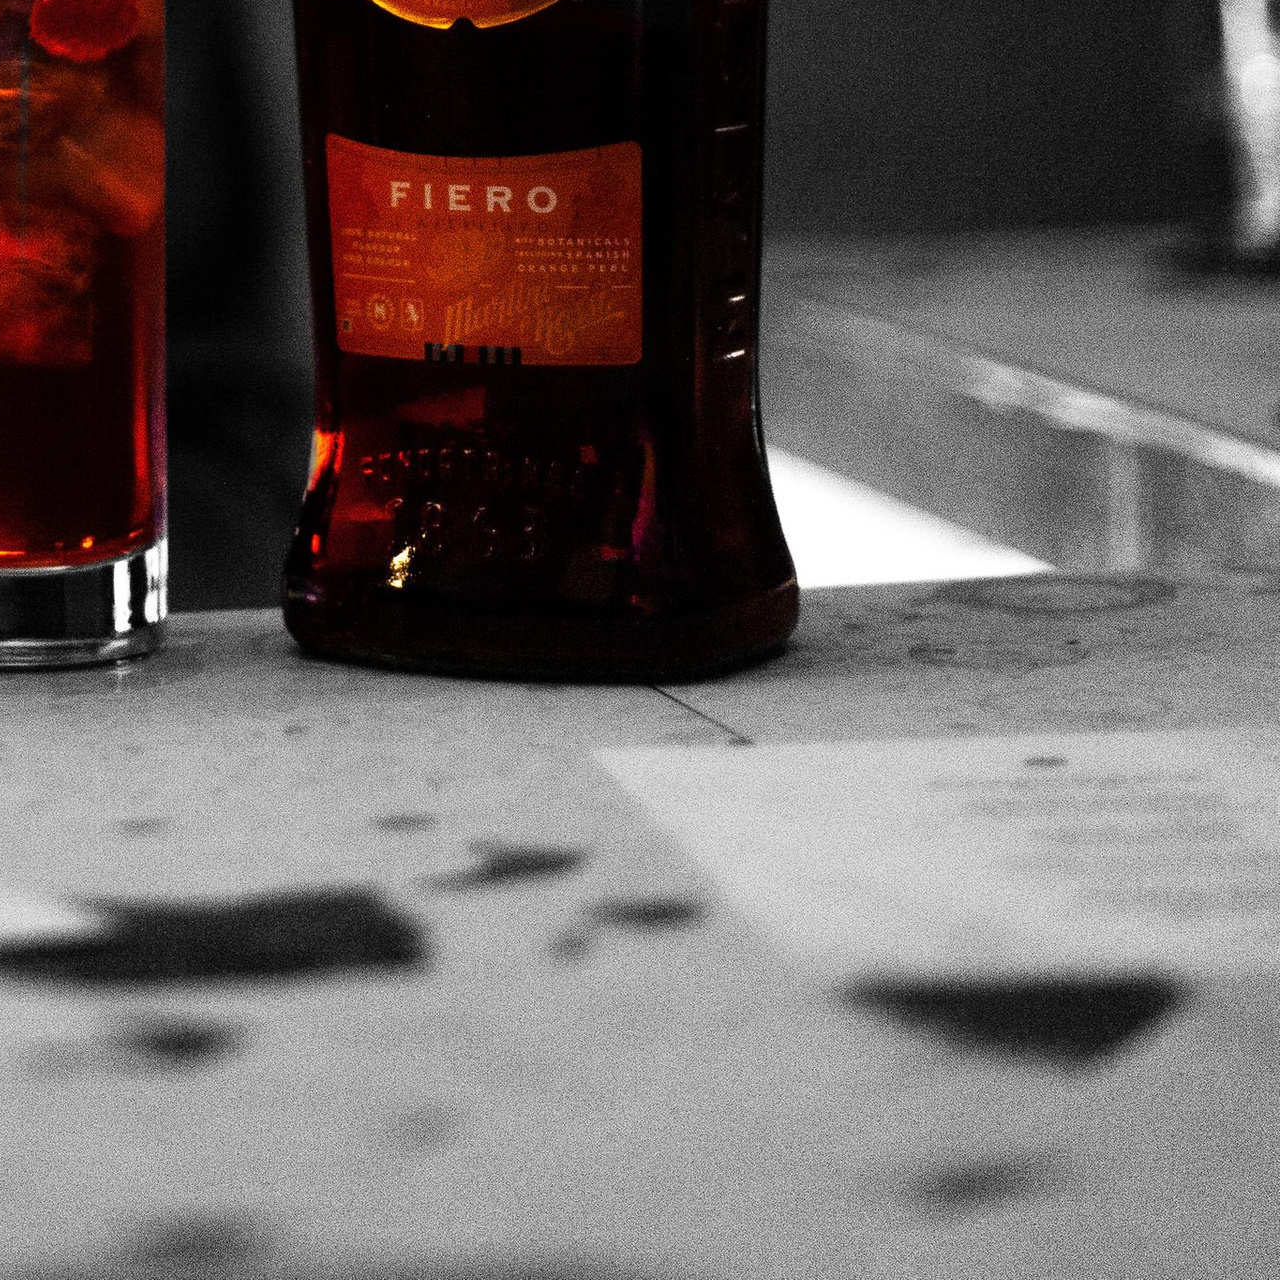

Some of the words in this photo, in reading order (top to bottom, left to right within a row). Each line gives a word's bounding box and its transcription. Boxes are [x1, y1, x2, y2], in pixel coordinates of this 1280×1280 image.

[389, 180, 558, 214] FIERO
[536, 236, 631, 248] BOTANICALS
[566, 249, 632, 260] SPANISH
[516, 262, 580, 274] ORANGE
[587, 262, 629, 274] PEEL
